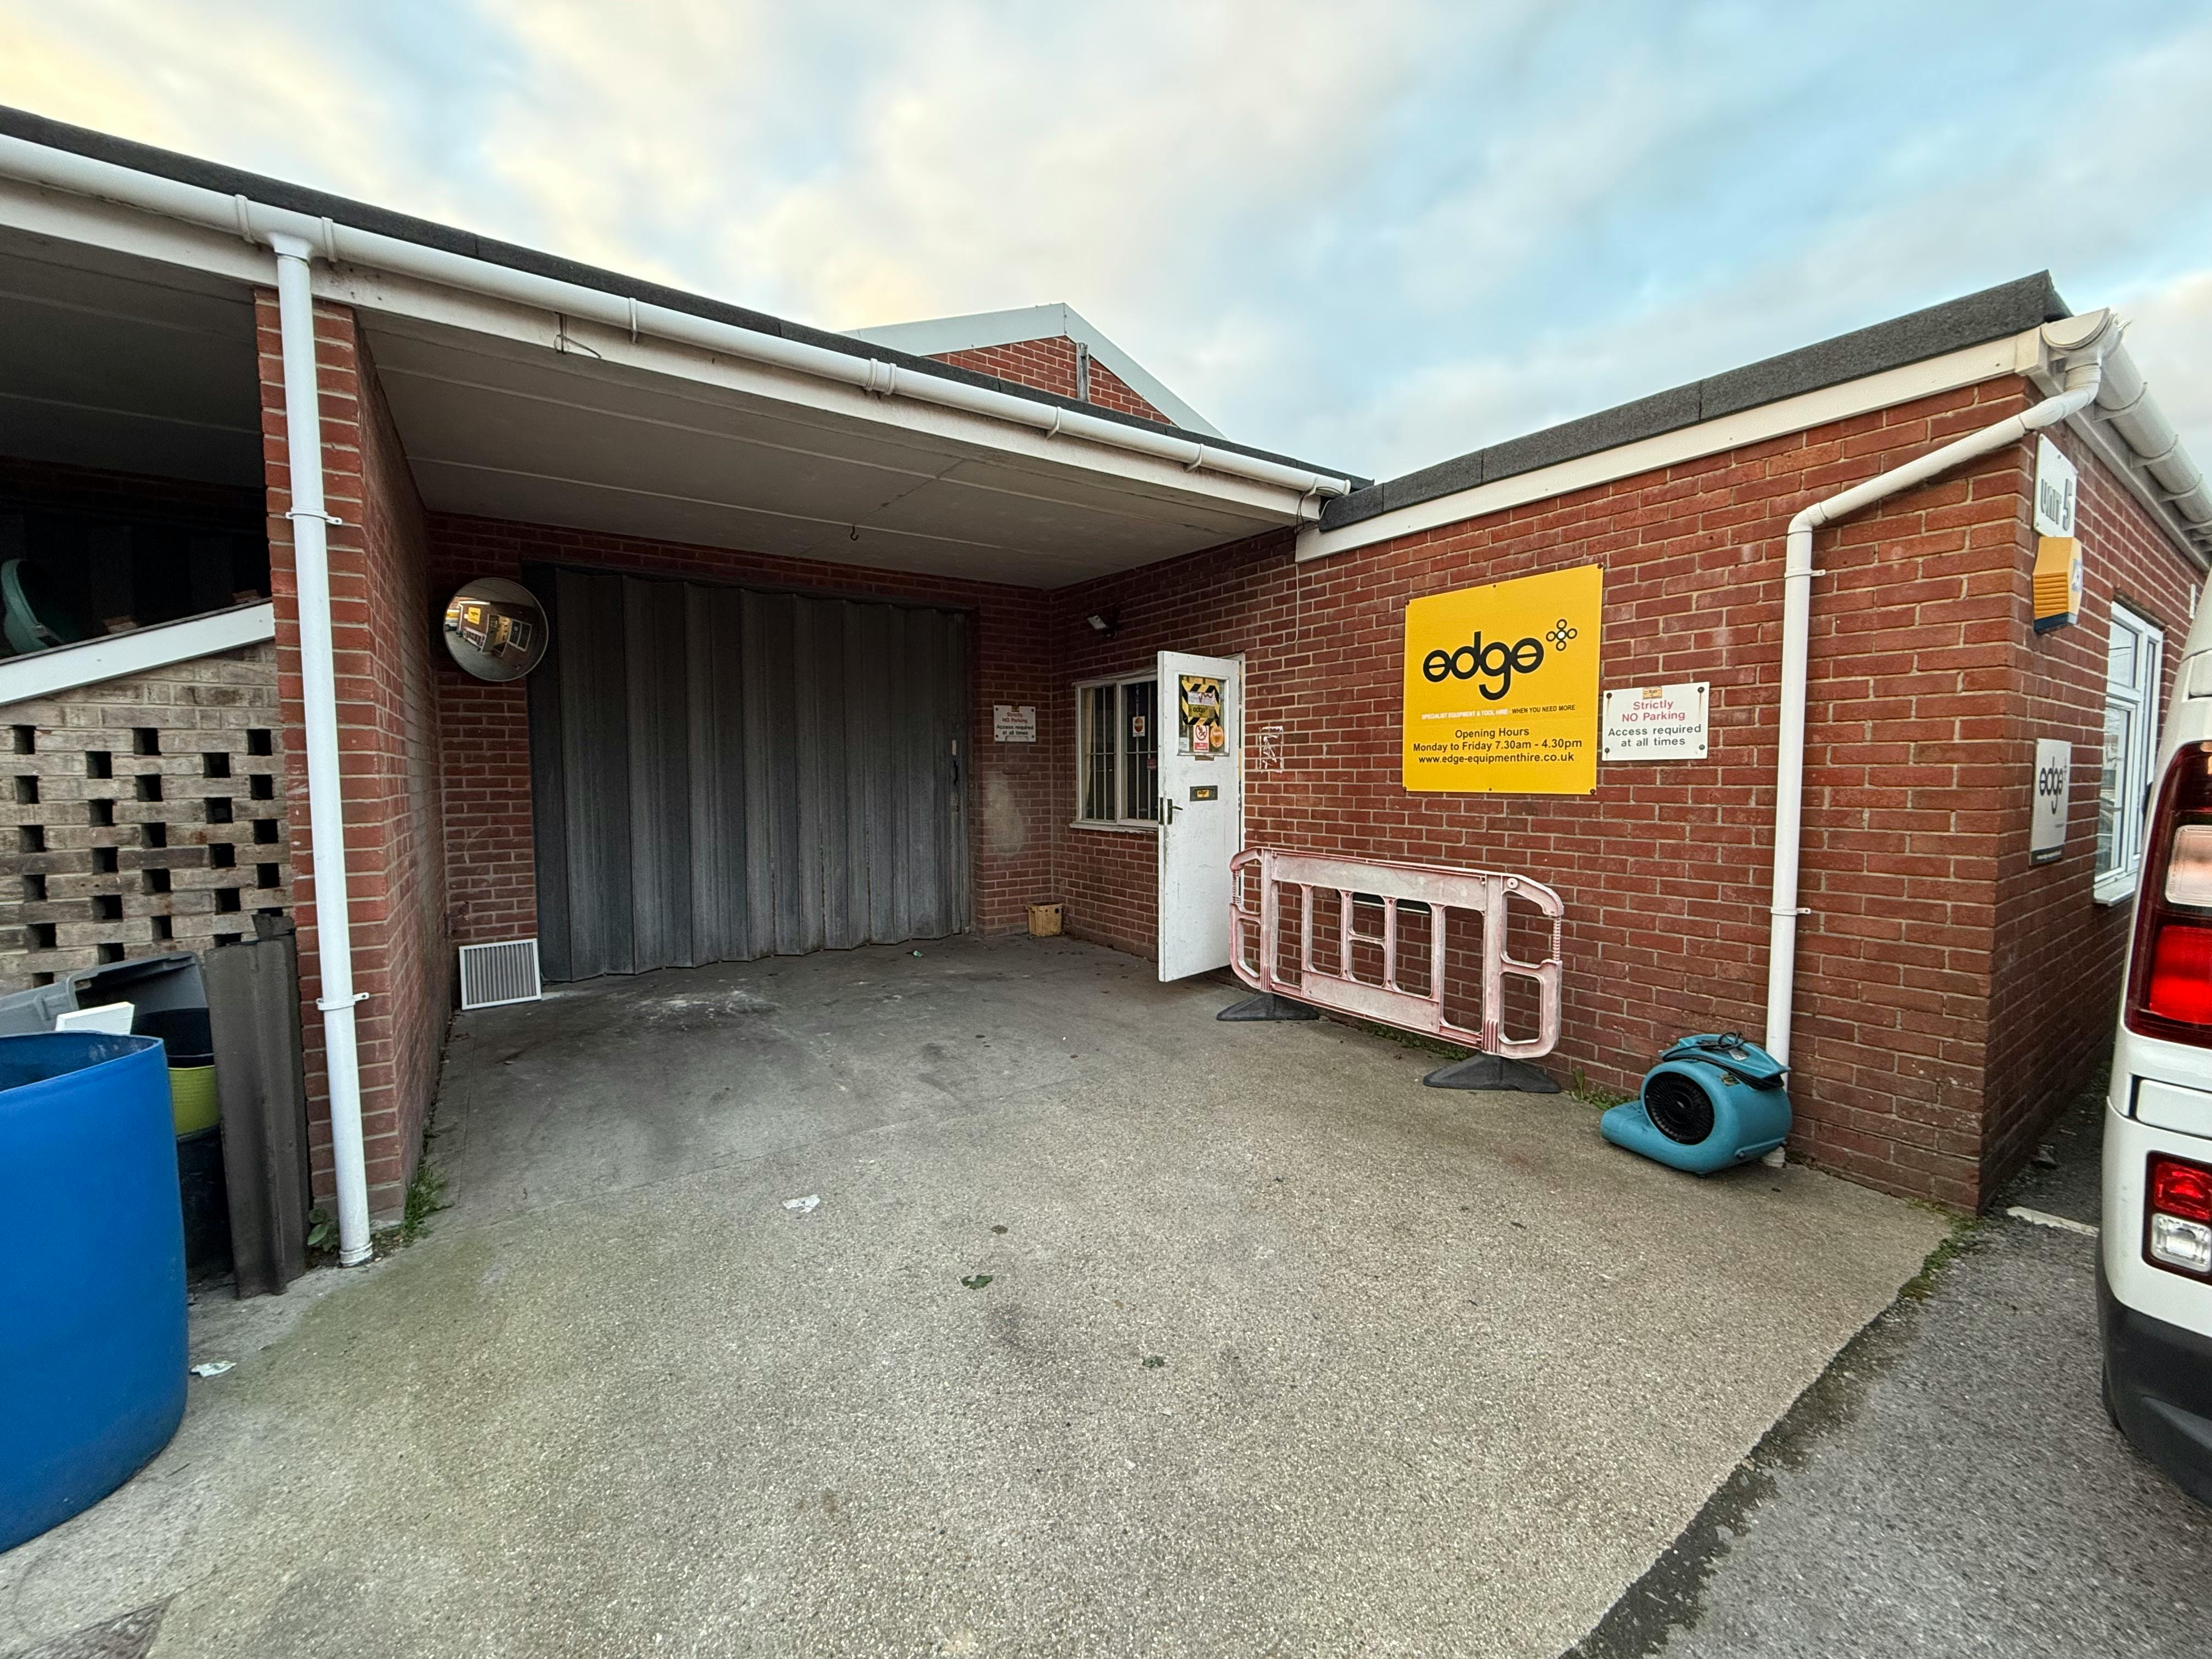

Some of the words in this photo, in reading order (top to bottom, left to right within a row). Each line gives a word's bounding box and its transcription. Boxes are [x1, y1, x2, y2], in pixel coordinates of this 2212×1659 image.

[2063, 478, 2072, 531] 5
[1423, 631, 1544, 700] edge
[1633, 699, 1674, 710] Strictly
[1448, 710, 1476, 719] EQUIPMENT
[1622, 713, 1638, 722] NO
[1643, 712, 1685, 721] Parking
[1455, 729, 1496, 740] Opening
[1499, 727, 1530, 737] Hours
[1608, 728, 1647, 736] Access
[1653, 724, 1701, 736] required
[1413, 742, 1448, 753] Monday
[1450, 742, 1459, 751] to
[1462, 741, 1492, 752] Friday
[1495, 740, 1531, 749] 7.30am
[1542, 738, 1582, 750] 4.30pm
[1636, 738, 1649, 746] all
[1654, 737, 1686, 746] times
[1419, 752, 1575, 764] www.edge-equipmenthire.co.uk
[2039, 757, 2064, 815] edge
